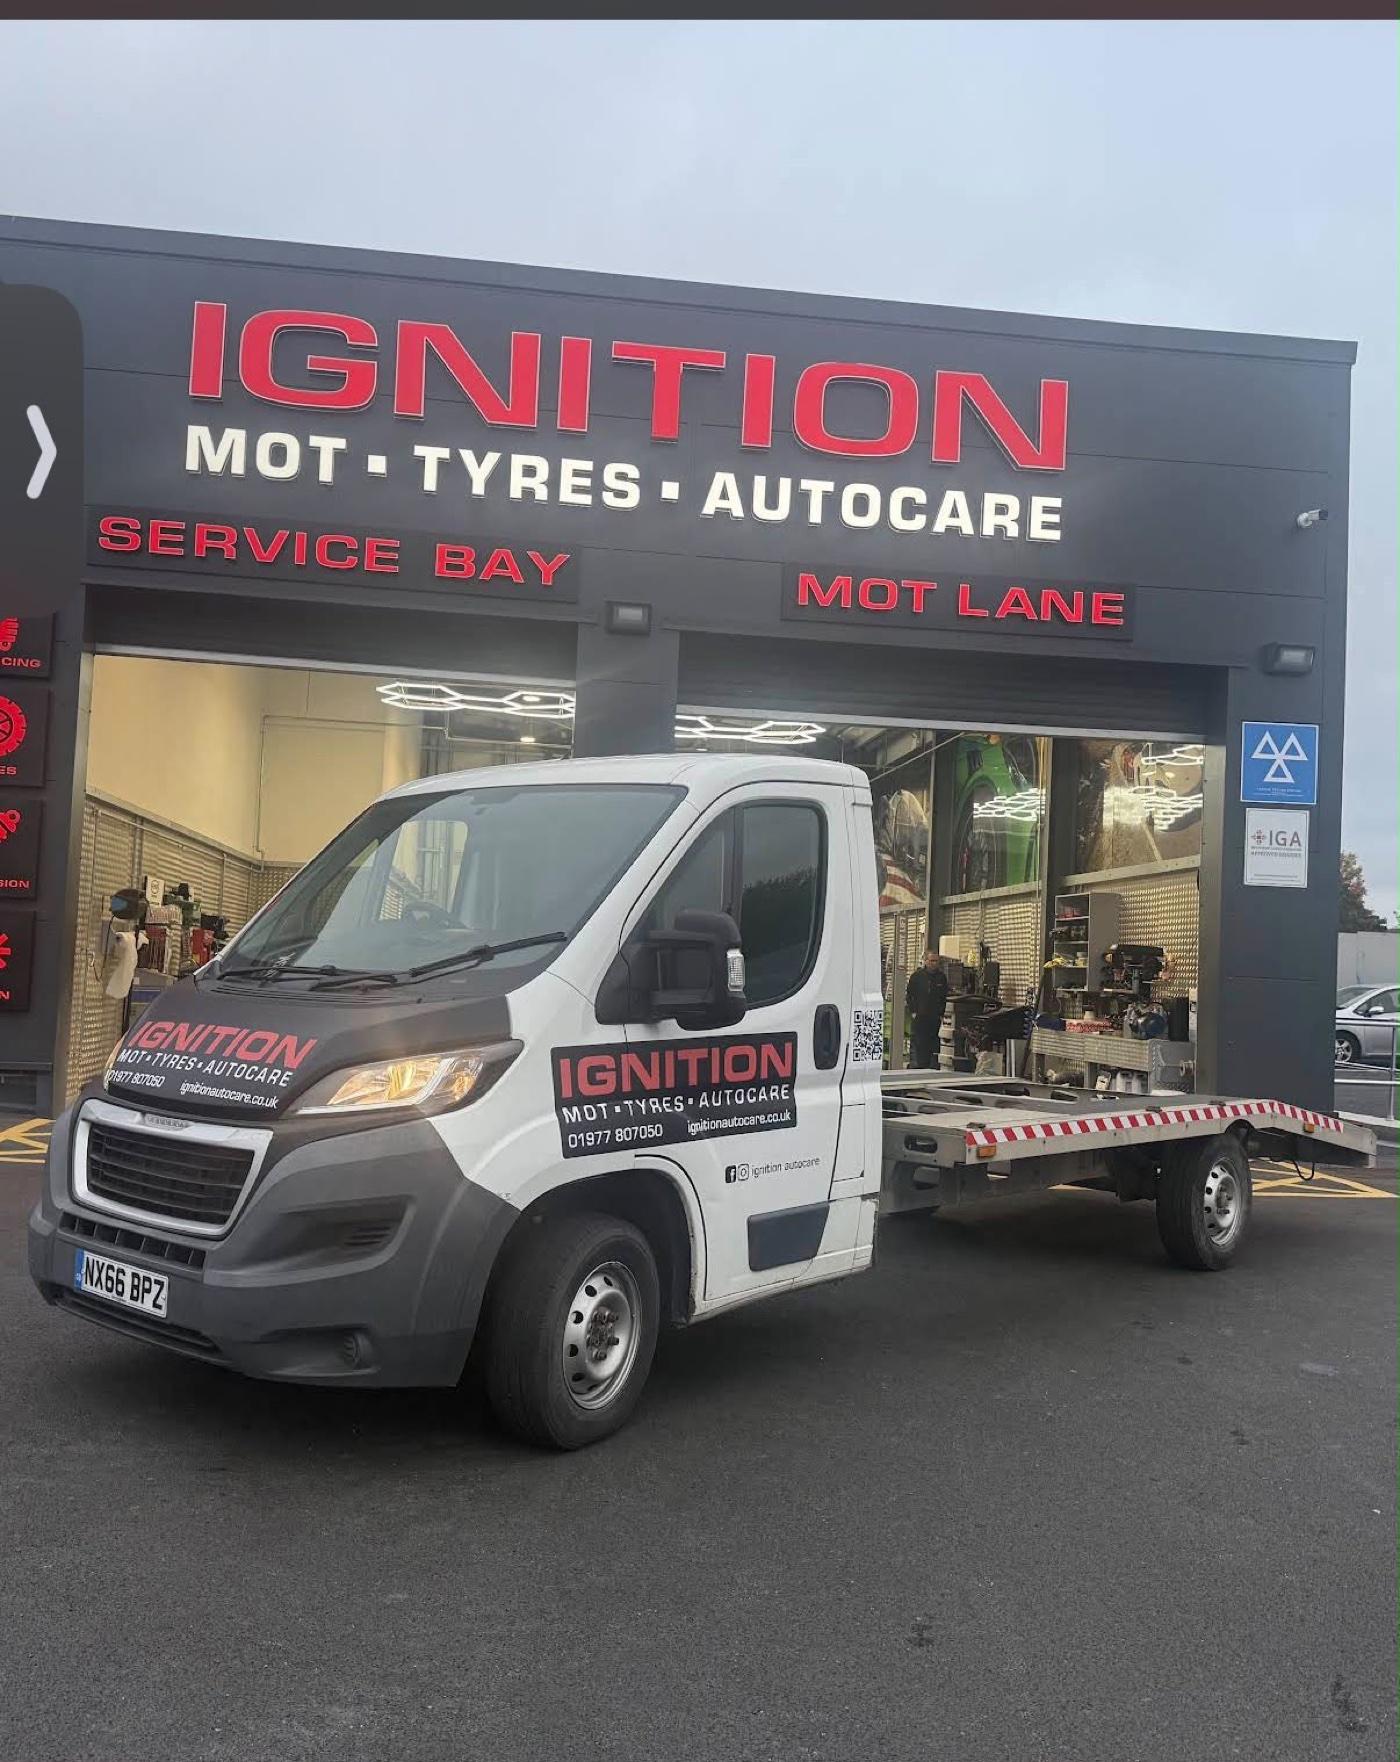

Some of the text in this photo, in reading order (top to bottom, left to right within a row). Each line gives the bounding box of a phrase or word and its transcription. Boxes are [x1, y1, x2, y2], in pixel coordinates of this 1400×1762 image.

[188, 300, 1069, 472] IGNITION
[185, 424, 1063, 543] MOT TYRES AUTOCARE
[98, 515, 571, 586] SERVICE BAY
[797, 572, 1125, 626] MOT LANE
[1269, 830, 1302, 847] IGA
[128, 1021, 318, 1069] IGNITION
[107, 1069, 134, 1084] 01977
[117, 1048, 293, 1087] MOT TYRES AUTOCARE
[560, 1042, 793, 1099] IGNITION
[180, 1081, 279, 1109] ignitionautocare.co.uk
[561, 1084, 790, 1124] MOT TYRES AUTOCARE
[568, 1123, 664, 1149] 01977 807050
[687, 1108, 792, 1136] ignitionautocare.co.uk
[751, 1162, 782, 1178] ignition
[784, 1157, 820, 1171] autocare
[85, 1256, 165, 1311] NX66 BPZ
